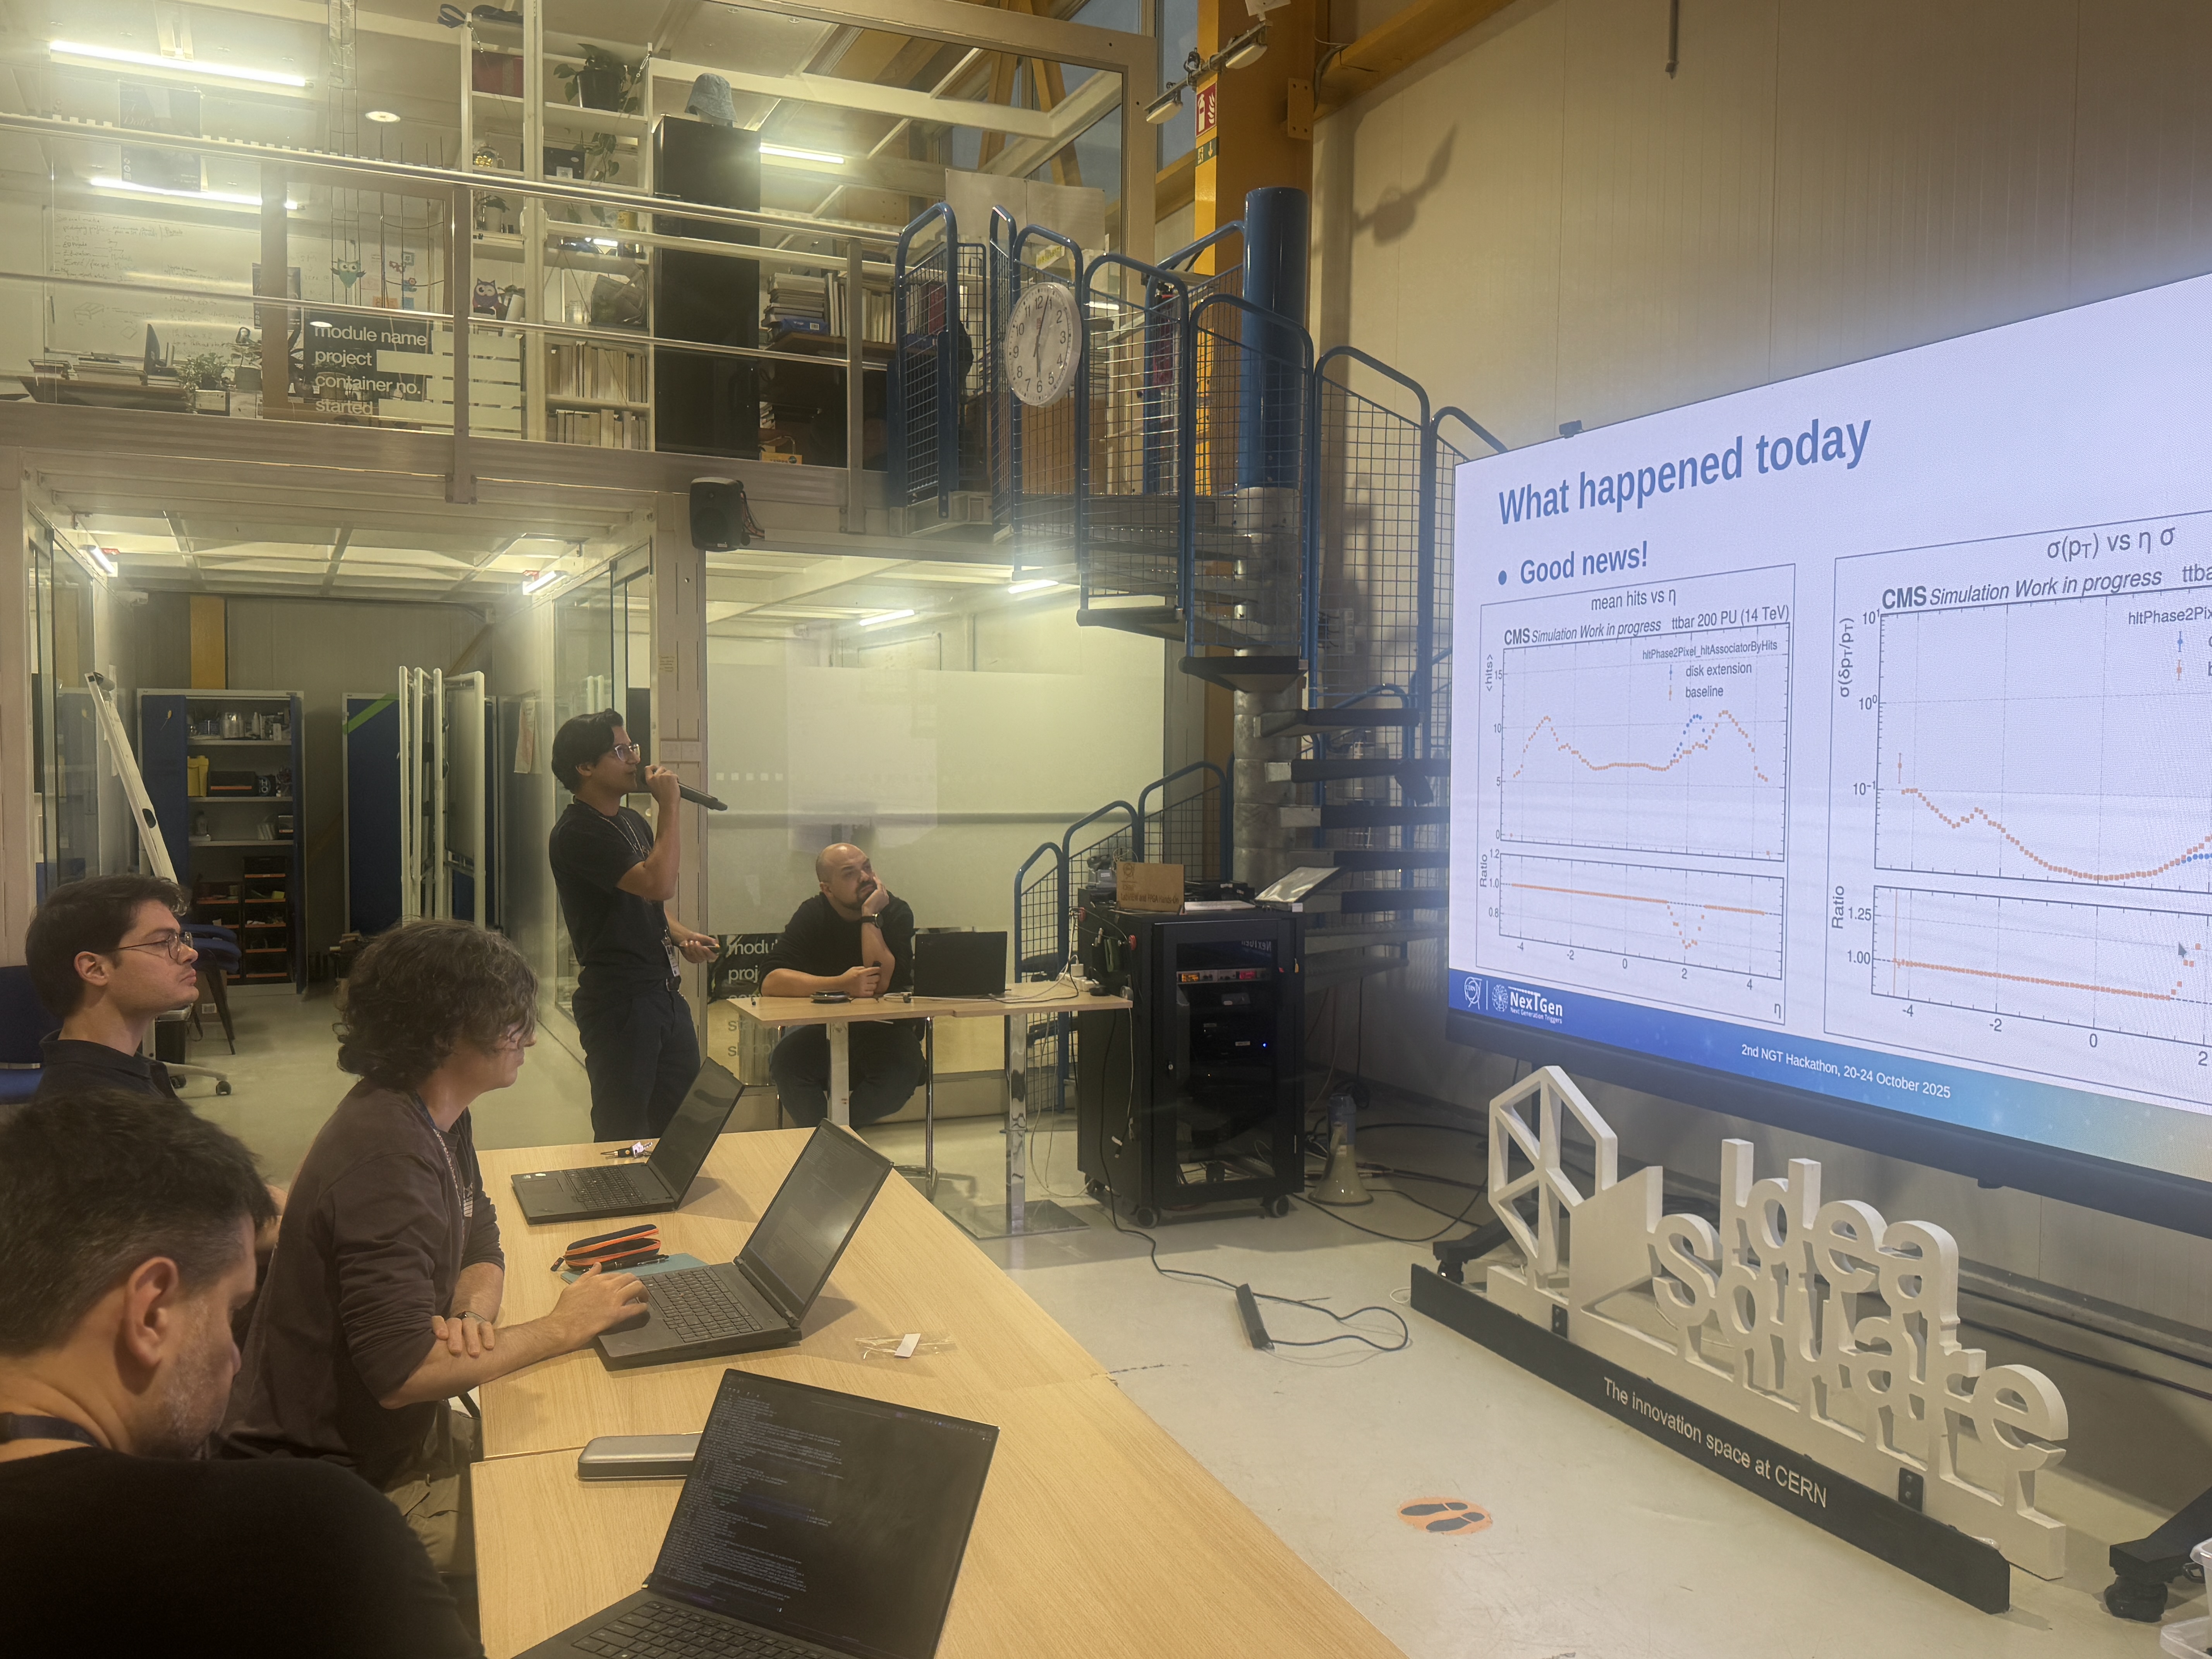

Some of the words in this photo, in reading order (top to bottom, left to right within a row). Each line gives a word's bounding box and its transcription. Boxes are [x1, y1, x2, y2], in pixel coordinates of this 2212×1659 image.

[1035, 296, 1043, 309] 12
[1049, 298, 1052, 309] 1
[1025, 306, 1030, 318] 11
[1056, 310, 1062, 323] 2
[314, 325, 377, 342] module
[381, 331, 426, 346] name
[1017, 323, 1024, 336] 10
[1060, 331, 1066, 344] 3
[315, 350, 372, 366] project
[1013, 346, 1019, 358] 9
[1057, 354, 1063, 365] 4
[1017, 366, 1022, 378] 8
[315, 375, 392, 392] container
[397, 381, 421, 395] no.
[1025, 378, 1031, 391] 7
[1048, 373, 1054, 385] 5
[1037, 381, 1042, 392] 6
[315, 399, 373, 415] started
[1499, 480, 1569, 524] What
[1580, 436, 1742, 513] happened
[1756, 419, 1871, 474] today
[2107, 534, 2130, 551] vs
[1521, 551, 1574, 584] Good
[1583, 541, 1647, 575] news!
[1882, 586, 1926, 609] CMS
[1930, 584, 2009, 605] Simulation
[2016, 577, 2058, 597] Work
[2063, 576, 2077, 593] in
[2082, 571, 2162, 599] progress
[1592, 596, 1622, 610] mean
[1627, 591, 1647, 606] hits
[1651, 591, 1664, 603] vs
[1504, 628, 1530, 645] CMS
[1532, 628, 1577, 642] Simulation
[1581, 623, 1604, 638] Work
[1606, 623, 1615, 635] in
[1618, 618, 1661, 639] progress
[1672, 616, 1695, 629] ttbar
[1698, 613, 1717, 627] 200
[1721, 610, 1736, 625] PU
[1741, 608, 1758, 626] (14
[1762, 605, 1789, 622] TeV)
[1495, 670, 1503, 679] 15
[1686, 665, 1704, 677] disk
[1707, 662, 1752, 675] extension
[1686, 686, 1723, 698] baseline
[1493, 724, 1501, 733] 10
[1496, 777, 1500, 786] 5
[1496, 830, 1500, 840] 0
[1490, 849, 1499, 859] 1.2
[1490, 878, 1499, 888] 1.0
[1489, 907, 1499, 918] 0.8
[1832, 886, 1844, 929] Ratio
[1849, 907, 1871, 921] 1.25
[1517, 942, 1523, 951] -4
[1567, 950, 1574, 960] -2
[1848, 950, 1870, 964] 1.00
[1623, 958, 1627, 969] 0
[728, 965, 760, 984] proj
[1682, 968, 1687, 979] 2
[1747, 979, 1752, 990] 4
[1509, 987, 1563, 1017] NexTGen
[1903, 1005, 1913, 1017] -4
[1990, 1018, 2002, 1032] -2
[2090, 1034, 2097, 1048] 0
[2198, 1051, 2208, 1066] 2
[1742, 1044, 1758, 1057] 2nd
[1762, 1048, 1783, 1062] NGT
[1786, 1053, 1840, 1077] Hackathon,
[1844, 1066, 1873, 1082] 20-24
[1877, 1073, 1919, 1091] October
[1923, 1082, 1950, 1098] 2025
[1721, 1139, 1958, 1311] Idea
[1604, 1377, 1628, 1405] The
[1632, 1391, 1702, 1443] innovation
[1706, 1433, 1750, 1470] space
[1755, 1458, 1771, 1479] at
[1775, 1465, 1826, 1507] CERN
